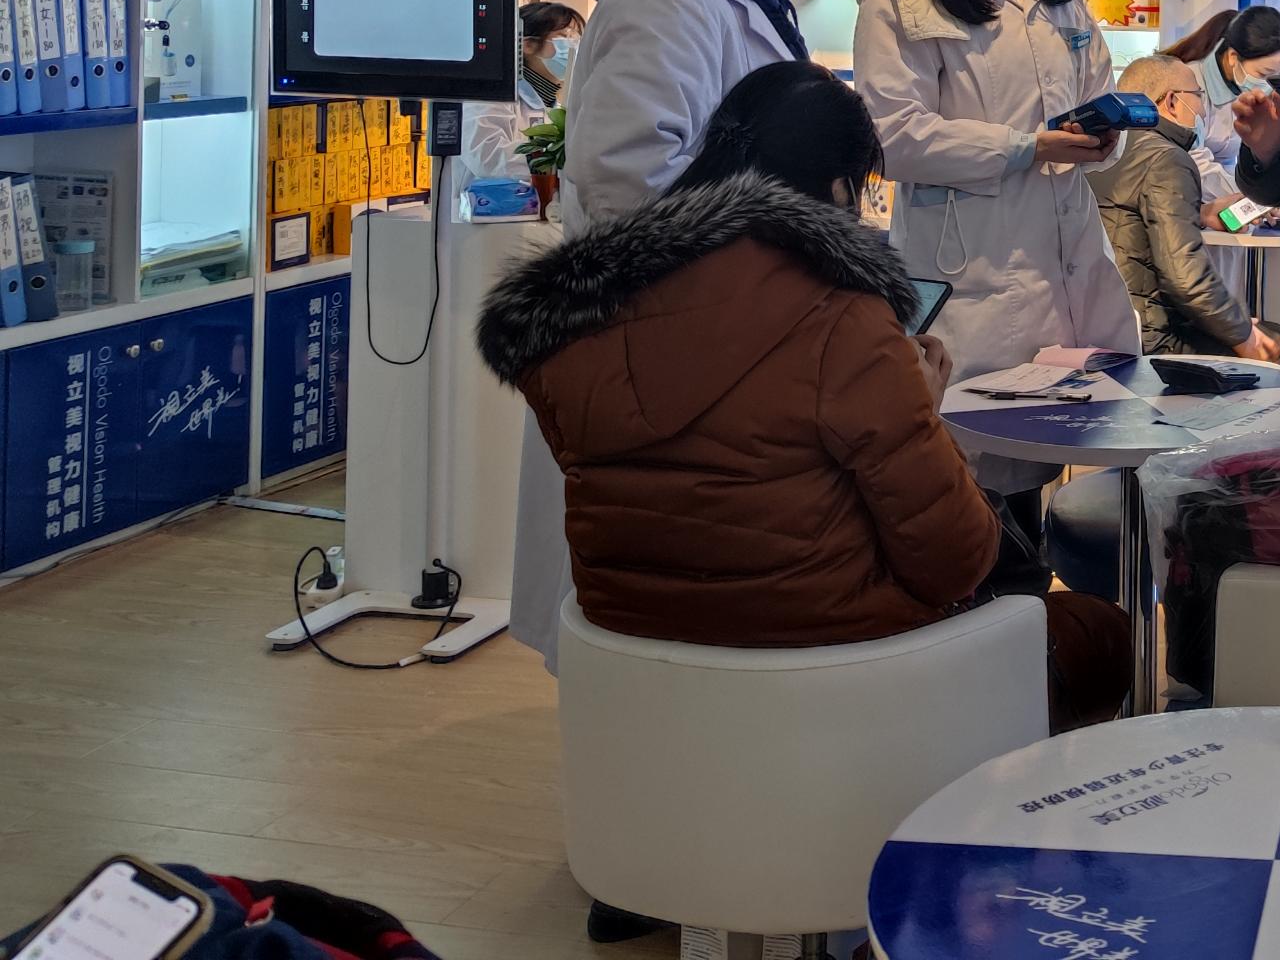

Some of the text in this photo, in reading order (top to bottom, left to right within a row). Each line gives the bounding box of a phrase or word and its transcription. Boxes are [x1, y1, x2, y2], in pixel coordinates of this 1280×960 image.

[92, 346, 113, 524] Olgodo Vision Health
